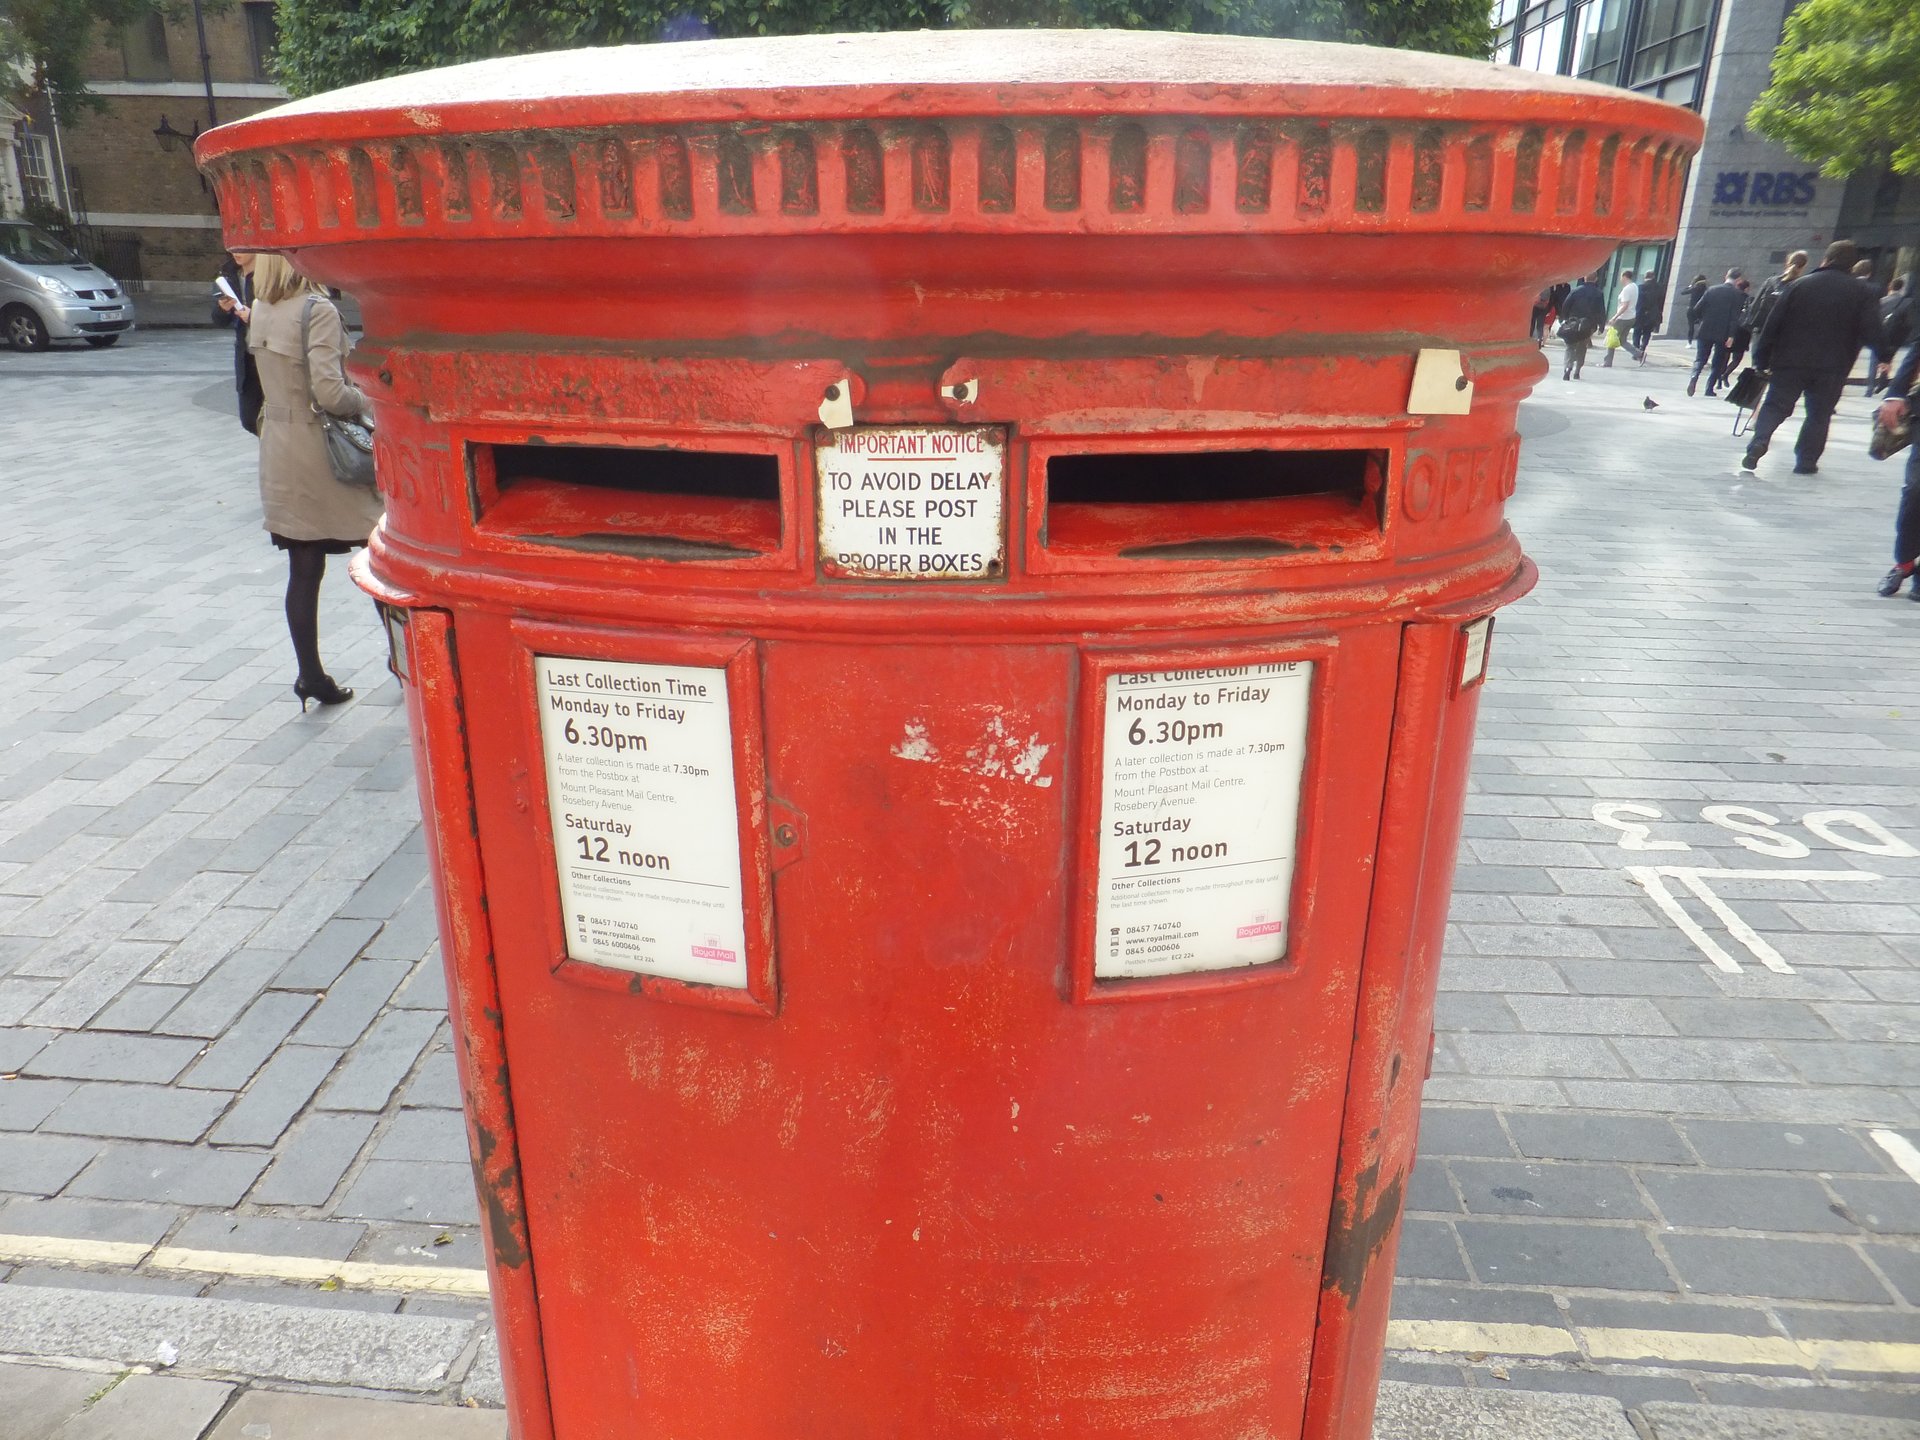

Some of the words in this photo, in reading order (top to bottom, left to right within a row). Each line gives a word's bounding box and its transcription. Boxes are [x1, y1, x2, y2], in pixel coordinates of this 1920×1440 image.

[1749, 172, 1819, 205] RBS
[840, 434, 926, 454] IMPORTANT
[932, 434, 984, 453] NOTICE
[828, 472, 852, 491] TO
[861, 472, 921, 491] AVOID
[931, 472, 992, 491] DELAY
[842, 499, 916, 518] PLEASE
[925, 499, 977, 518] POST
[879, 527, 896, 545] IN
[905, 527, 942, 545] THE
[919, 553, 983, 572] BOXES
[547, 670, 580, 687] Last
[585, 672, 661, 693] Collection
[665, 678, 707, 697] Time
[1117, 693, 1187, 712] Monday
[1193, 691, 1210, 706] to
[1217, 686, 1271, 704] Friday
[551, 695, 609, 718] Monday
[615, 702, 630, 716] to
[637, 703, 685, 724] Friday
[564, 718, 648, 753] 6.30pm
[1128, 717, 1223, 745] 6.30pm
[1114, 757, 1122, 767] A
[1124, 755, 1146, 766] later
[1149, 750, 1193, 765] collection
[1196, 751, 1204, 760] is
[1207, 747, 1233, 758] made
[1236, 746, 1246, 755] at
[1248, 742, 1285, 755] 7.30pm
[558, 766, 579, 776] from
[580, 768, 594, 778] the
[596, 770, 629, 782] Postbox
[564, 753, 583, 764] later
[586, 755, 624, 769] collection
[636, 761, 660, 772] made
[662, 764, 671, 773] at
[673, 763, 710, 777] 7.30pm
[1114, 770, 1137, 782] from
[1141, 769, 1156, 779] the
[1159, 766, 1196, 777] Postbox
[1199, 764, 1209, 774] at
[560, 782, 587, 794] Mount
[589, 785, 624, 797] Pleasant
[626, 788, 644, 799] Mail
[1114, 787, 1145, 798] Mount
[1148, 782, 1188, 796] Pleasant
[1191, 779, 1211, 791] Mail
[1114, 798, 1157, 812] Rosebery
[565, 813, 632, 837] Saturday
[1113, 817, 1191, 837] Saturday
[577, 835, 610, 862] 12
[618, 849, 670, 870] noon
[1124, 838, 1161, 868] 12
[1171, 841, 1228, 862] noon
[571, 871, 591, 880] Other
[593, 874, 631, 886] Collections
[1111, 882, 1135, 890] Other
[1138, 877, 1181, 887] Collections
[590, 917, 611, 926] 08457
[613, 920, 638, 930] 740740
[1126, 925, 1150, 934] 08457
[1153, 921, 1182, 931] 740740
[592, 928, 656, 944] www.royalmail.com
[592, 938, 609, 946] 0845
[1126, 931, 1199, 945] www.royalmail.com
[1125, 947, 1144, 955] 0845
[1147, 943, 1180, 953] 6000606
